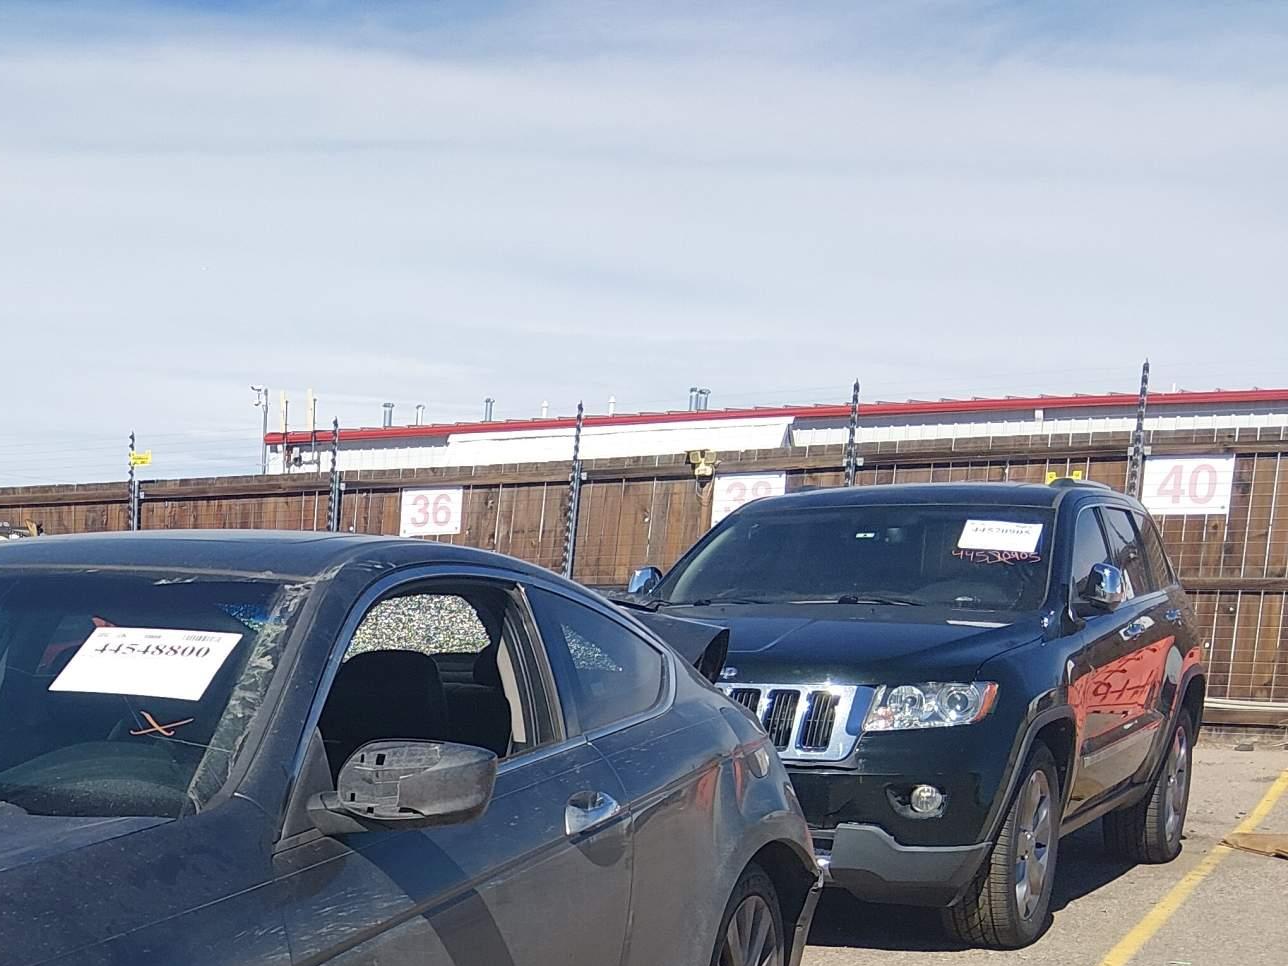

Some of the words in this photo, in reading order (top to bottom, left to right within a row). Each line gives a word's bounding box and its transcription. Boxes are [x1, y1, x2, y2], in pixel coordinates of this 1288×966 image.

[1157, 464, 1217, 504] 40
[410, 494, 452, 527] 36
[95, 643, 211, 659] 44548800
